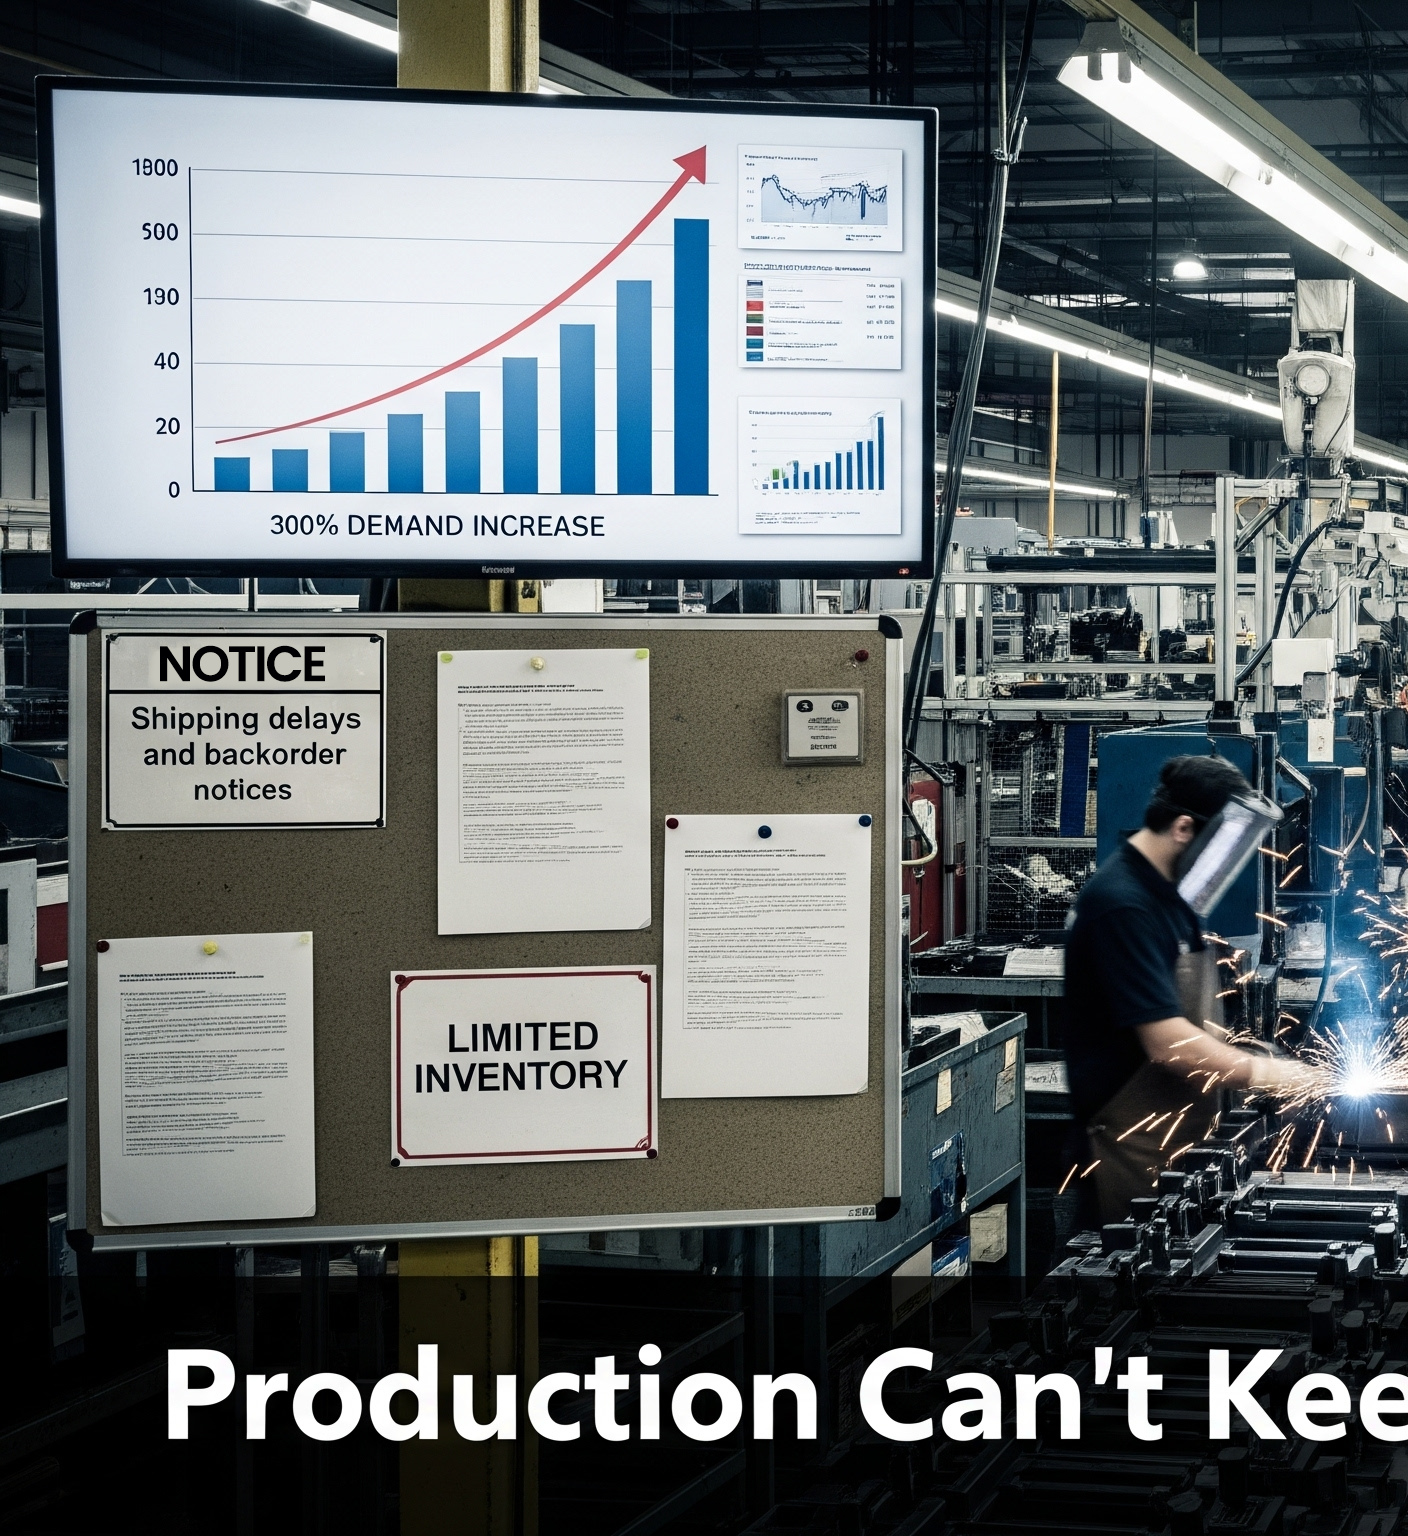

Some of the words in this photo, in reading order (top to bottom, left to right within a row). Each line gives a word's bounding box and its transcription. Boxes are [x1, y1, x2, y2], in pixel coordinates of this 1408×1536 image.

[142, 222, 179, 241] 500
[153, 351, 180, 370] 40
[155, 417, 180, 435] 20
[168, 481, 180, 499] 0
[270, 513, 339, 536] 300%
[348, 514, 464, 536] DEMAND
[473, 514, 605, 537] INCREASE
[158, 644, 327, 684] NOTICE
[131, 705, 259, 736] Shipping
[269, 705, 361, 735] delays
[143, 741, 195, 766] and
[205, 741, 347, 766] backorder
[194, 778, 292, 801] notices
[447, 1021, 599, 1053] LIMITED
[415, 1059, 628, 1094] INVENTORY
